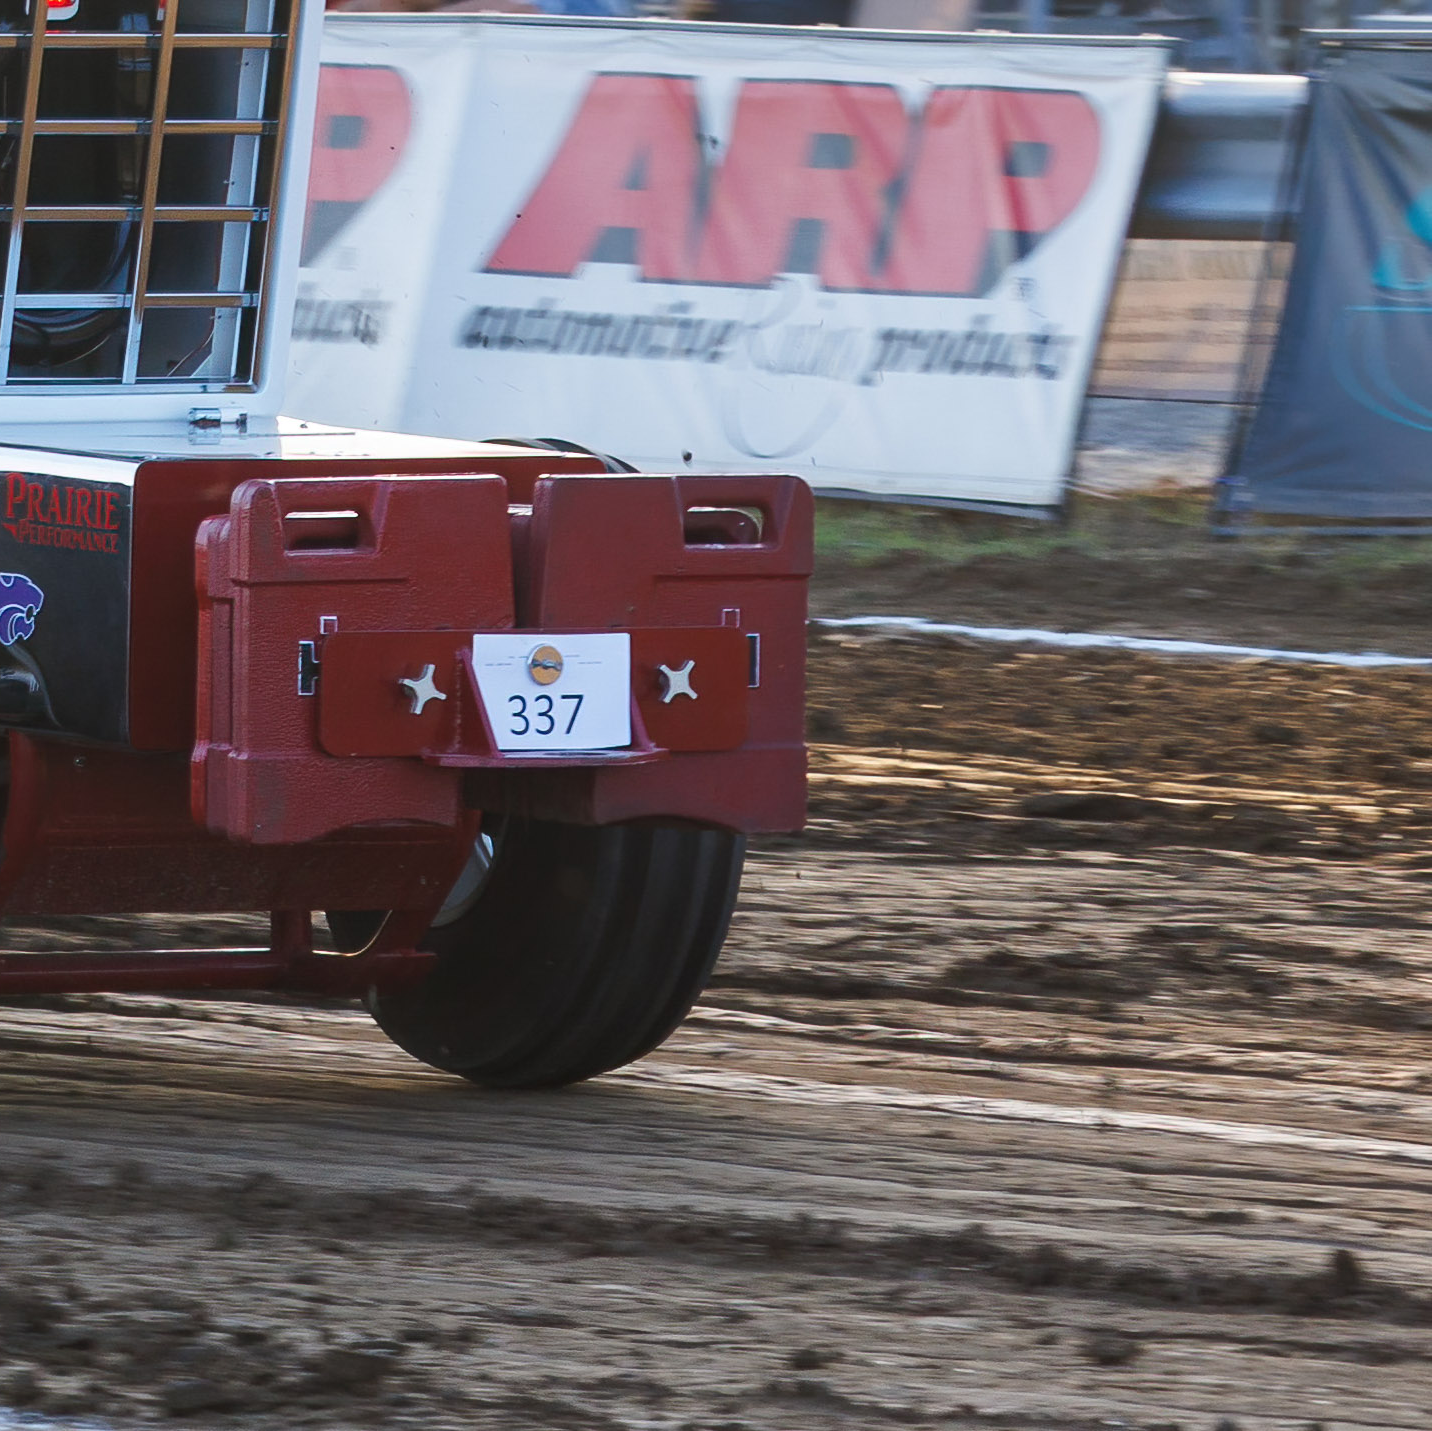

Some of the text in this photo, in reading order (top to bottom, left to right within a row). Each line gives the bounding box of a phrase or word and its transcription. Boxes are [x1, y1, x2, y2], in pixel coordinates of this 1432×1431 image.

[482, 71, 1101, 297] ARP
[18, 518, 119, 553] PERFORMANCE
[508, 694, 584, 735] 337
